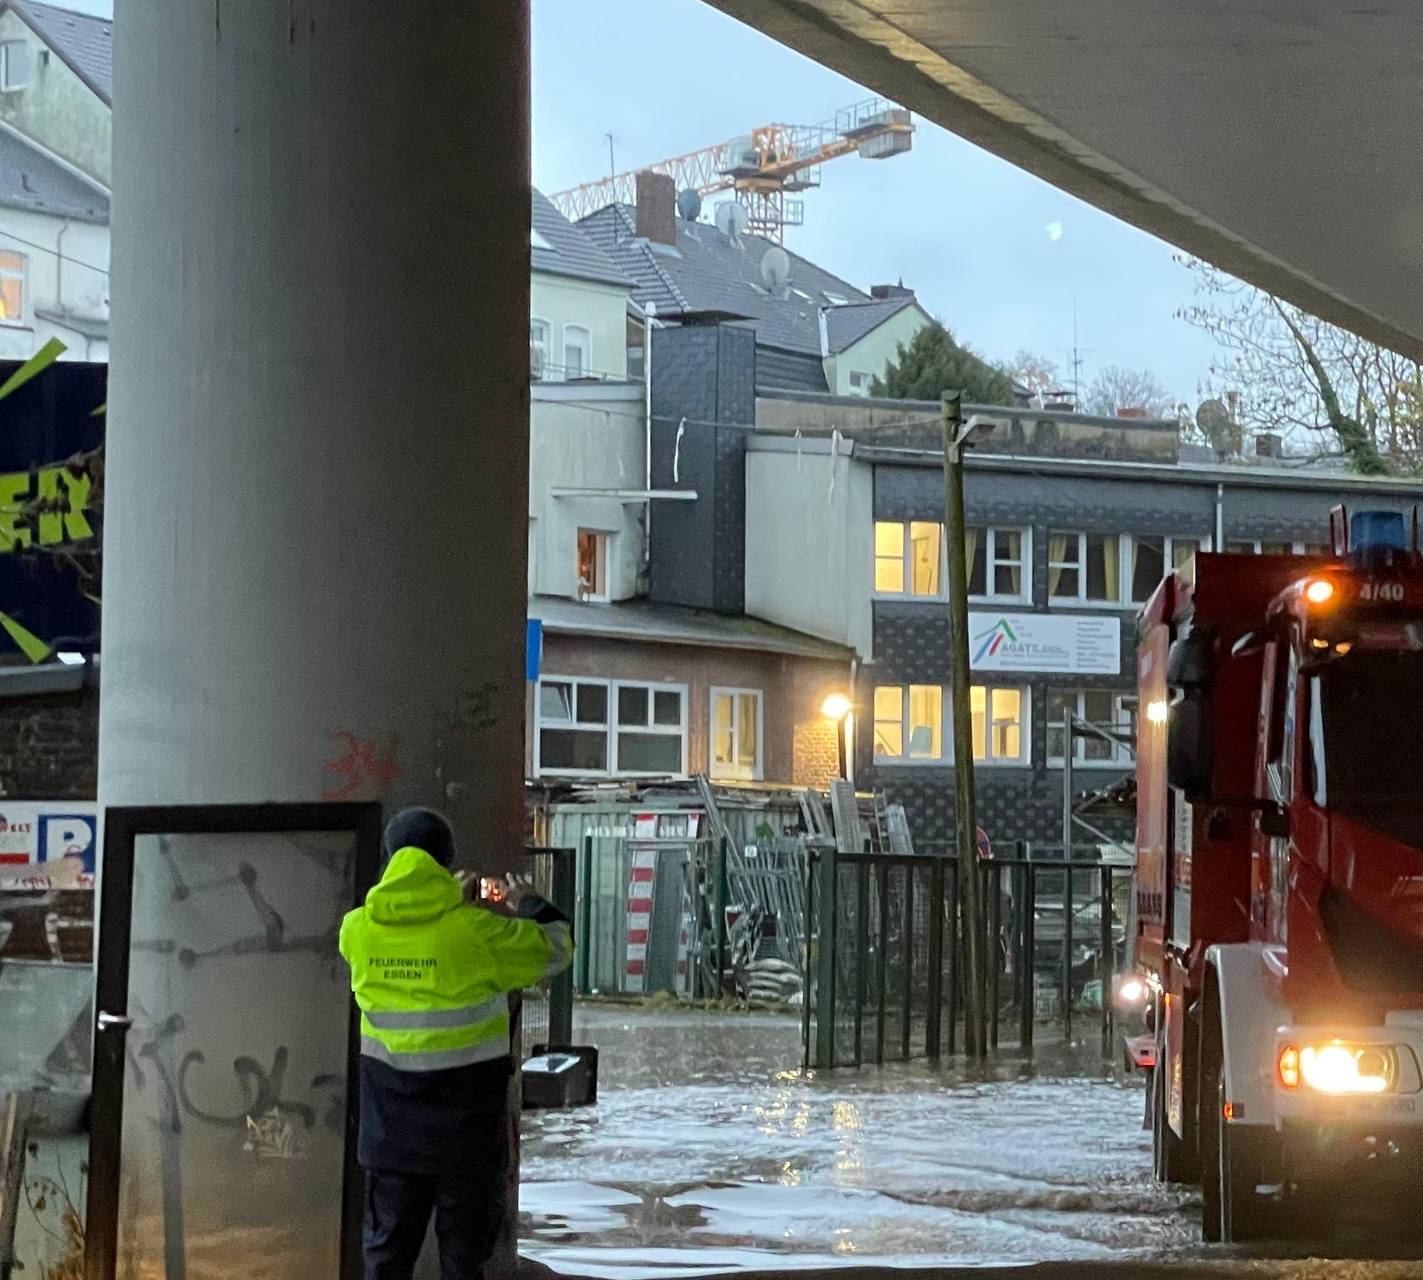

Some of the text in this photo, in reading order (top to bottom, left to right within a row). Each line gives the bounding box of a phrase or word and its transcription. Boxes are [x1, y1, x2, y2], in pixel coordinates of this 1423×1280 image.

[1360, 583, 1404, 601] 4/40
[369, 957, 437, 968] FEUERWEHR
[384, 969, 422, 980] ESSEN
